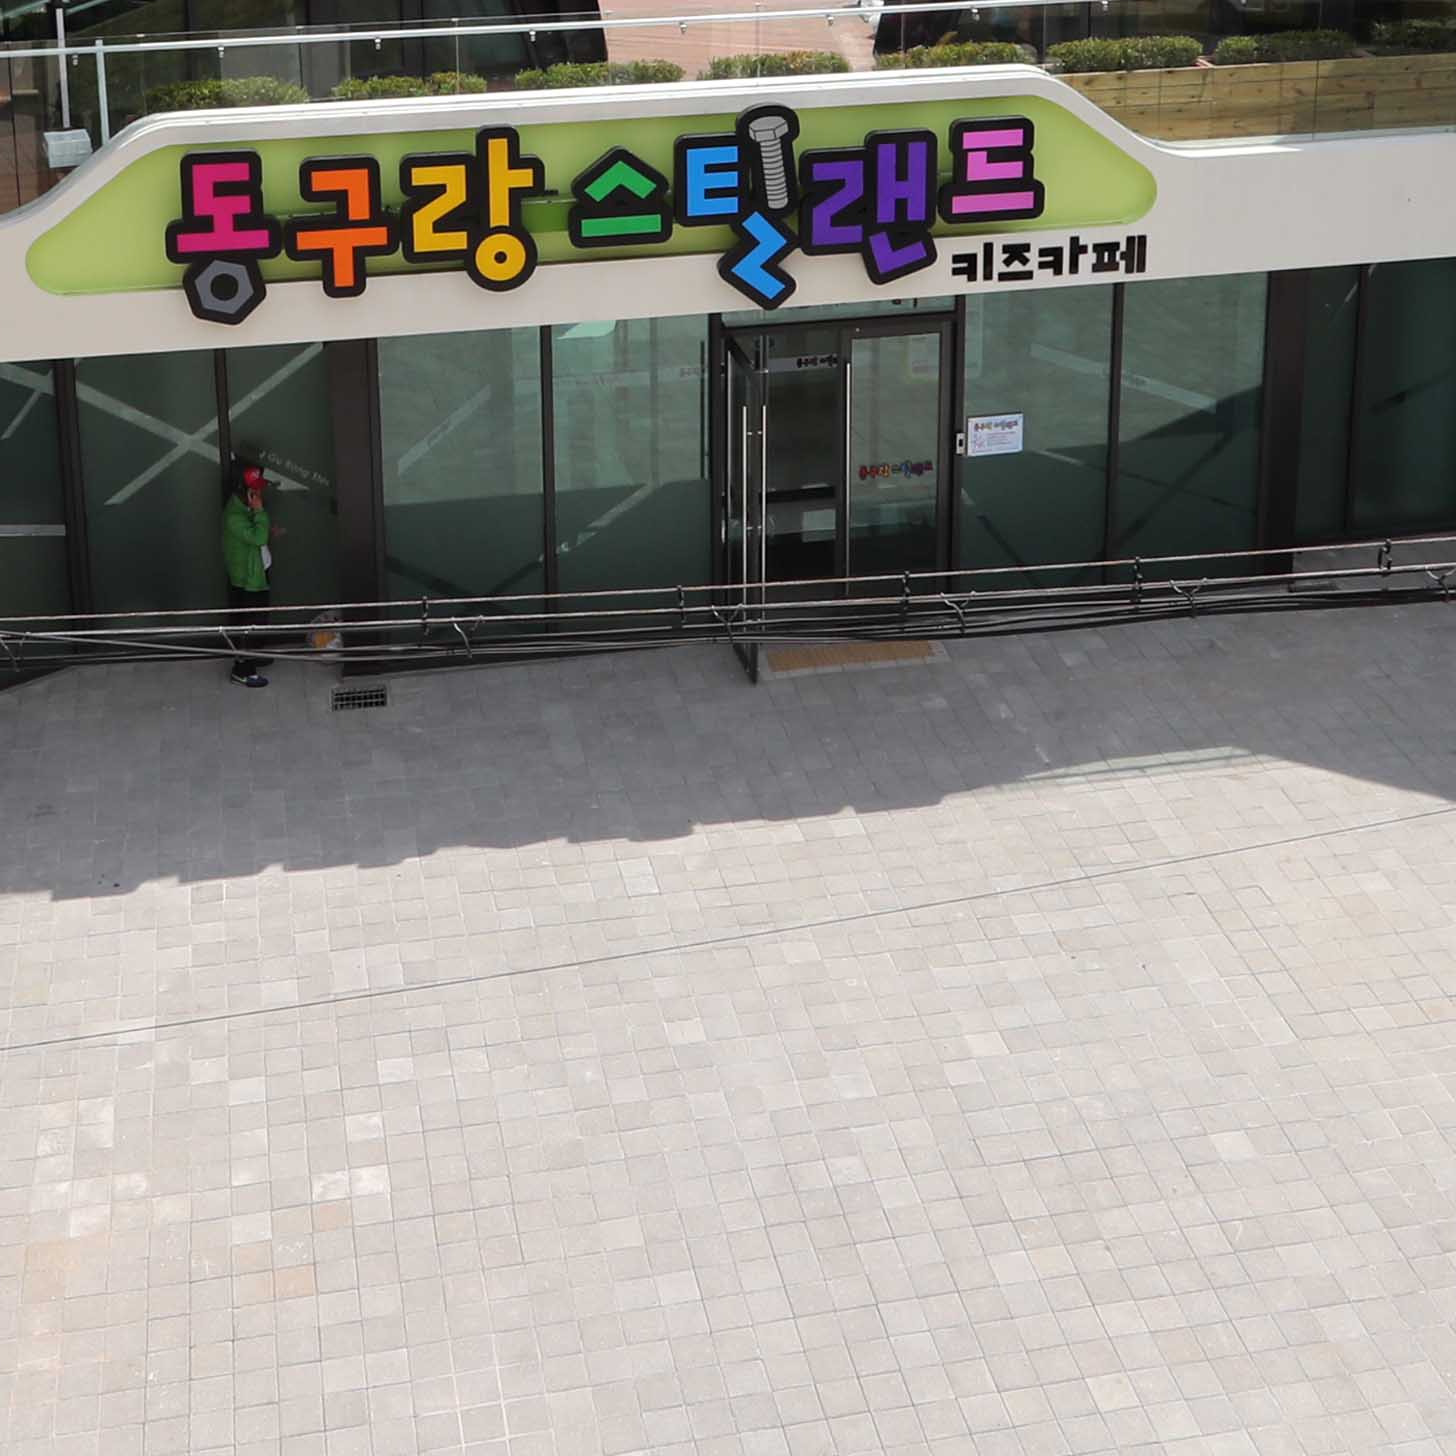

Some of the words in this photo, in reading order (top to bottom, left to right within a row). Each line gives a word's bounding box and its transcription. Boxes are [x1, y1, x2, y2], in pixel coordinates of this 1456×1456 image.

[166, 125, 539, 325] 동구랑
[569, 102, 1045, 310] 스틸랜드
[952, 235, 1147, 282] 키즈카페
